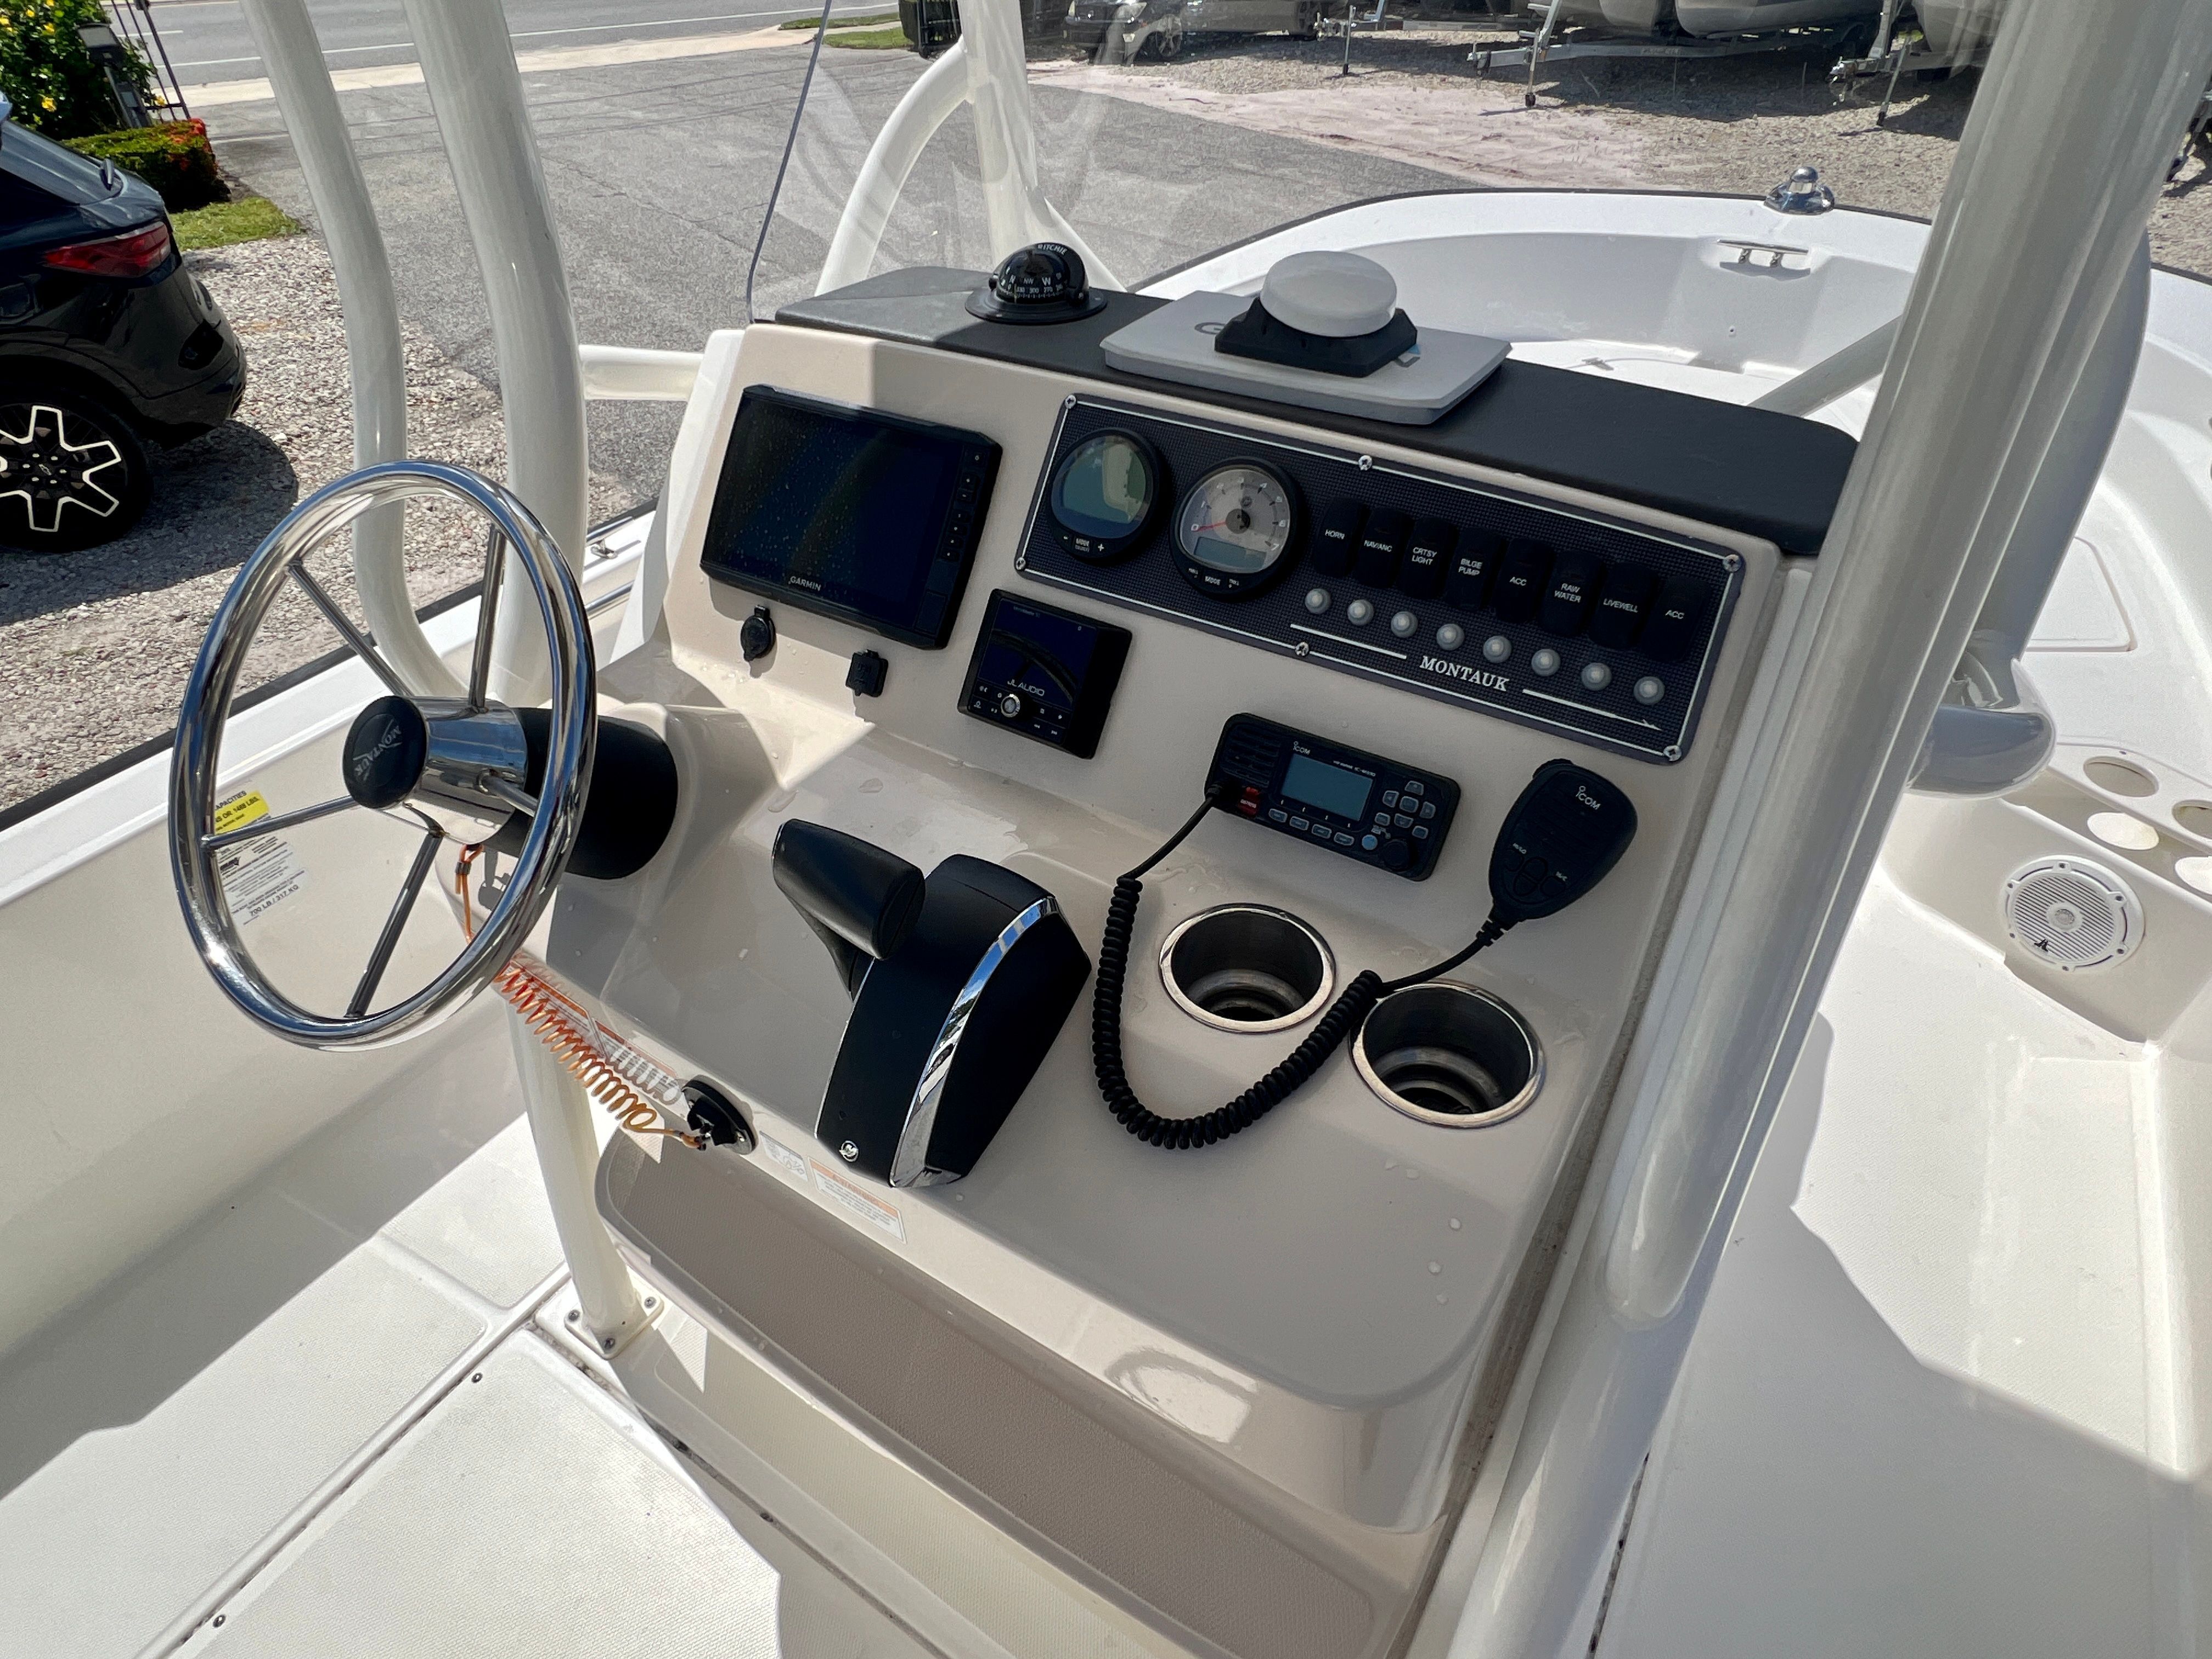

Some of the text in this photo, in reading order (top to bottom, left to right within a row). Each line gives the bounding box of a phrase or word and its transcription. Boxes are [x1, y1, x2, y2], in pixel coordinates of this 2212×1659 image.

[1037, 244, 1068, 255] RITCHIE
[1042, 277, 1051, 285] W
[1324, 529, 1345, 540] HORN
[1412, 546, 1437, 558] CRTSY
[1412, 555, 1433, 566] LIGHT
[1460, 558, 1482, 569] BILGE
[1458, 566, 1480, 576] PUMP
[790, 575, 822, 592] GARMIN
[1510, 577, 1527, 586] ACC
[1561, 583, 1581, 593] RAW
[1554, 590, 1582, 603] WATER
[1602, 597, 1639, 613] LIVEWELL
[1664, 610, 1685, 620] ACC
[1419, 655, 1510, 691] MONTAUK
[1007, 679, 1045, 697] JL AUDIO
[353, 721, 403, 780] MONTAUK
[215, 790, 247, 811] APACITIES
[222, 810, 233, 819] OR
[249, 906, 262, 917] 700
[261, 900, 273, 909] LB
[275, 890, 287, 902] 317
[287, 884, 299, 893] KG
